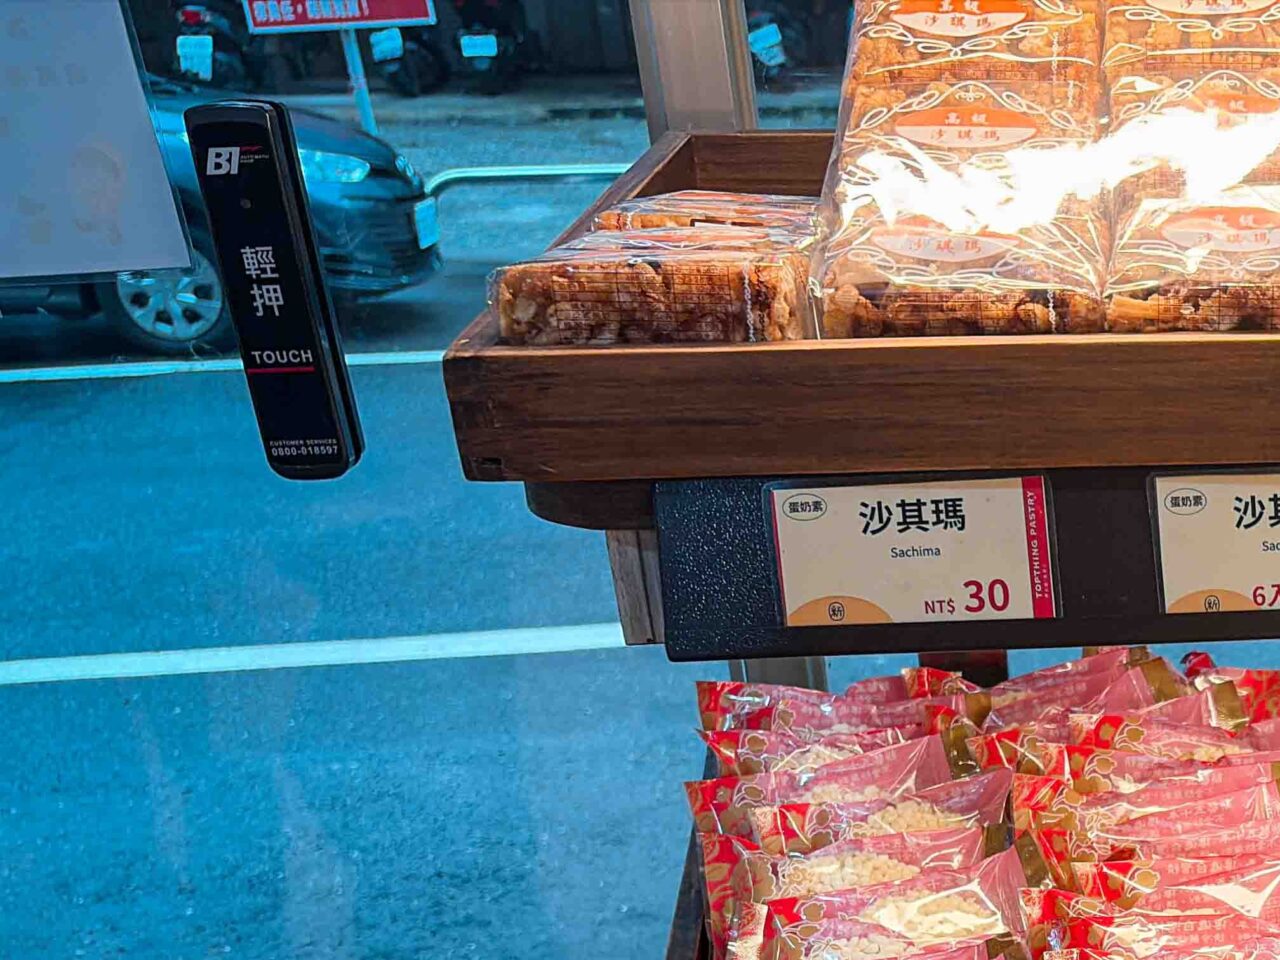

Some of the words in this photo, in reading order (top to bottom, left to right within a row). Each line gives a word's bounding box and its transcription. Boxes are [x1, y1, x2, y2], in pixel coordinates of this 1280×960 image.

[240, 246, 284, 317] 輕押
[251, 349, 314, 365] TOUCH
[271, 445, 338, 456] 0800-018597
[788, 501, 824, 514] 蛋奶素
[1026, 490, 1038, 536] PASTRY
[1170, 494, 1204, 508] 蛋奶素
[859, 497, 967, 536] 沙其瑪
[890, 546, 941, 558] Sachima
[1029, 539, 1043, 600] TOPTHING
[924, 598, 956, 616] NT$
[963, 578, 1010, 614] 30
